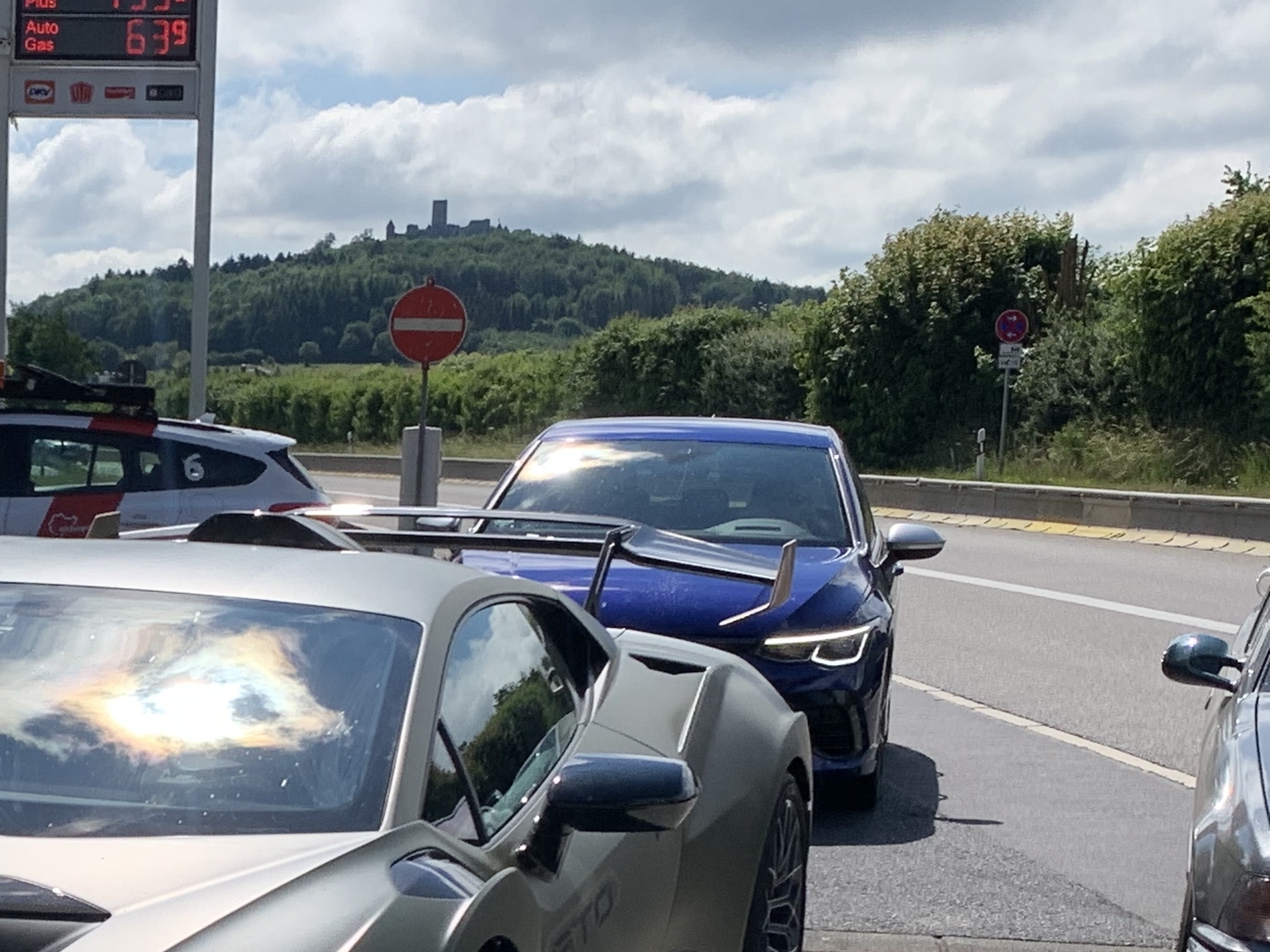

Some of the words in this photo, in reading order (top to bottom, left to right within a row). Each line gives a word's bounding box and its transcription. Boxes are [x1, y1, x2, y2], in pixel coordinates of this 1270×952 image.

[25, 20, 59, 35] Auto
[24, 37, 55, 51] Gas
[183, 453, 205, 481] 6
